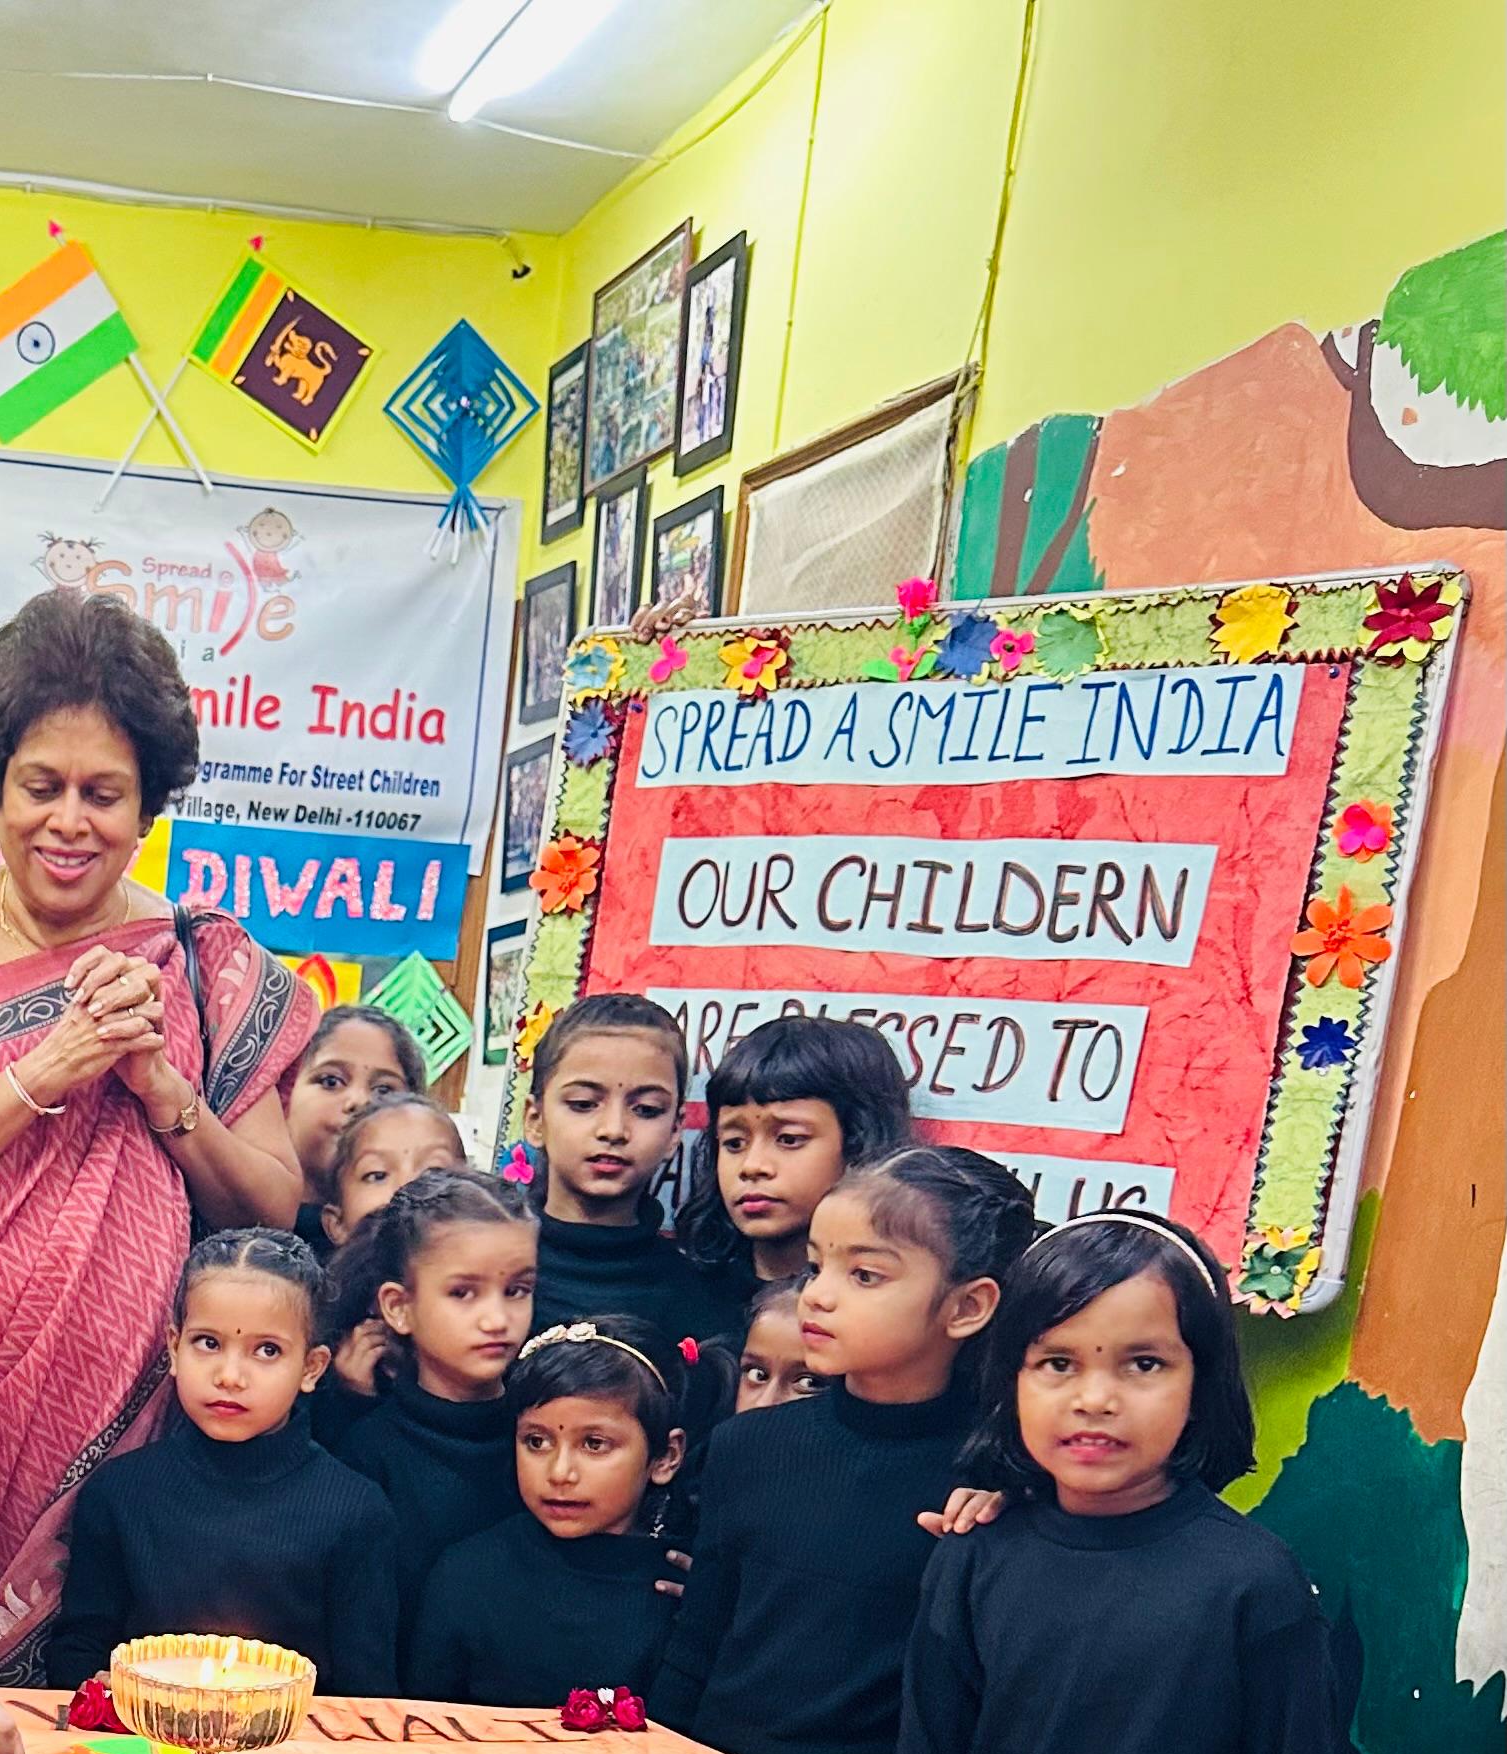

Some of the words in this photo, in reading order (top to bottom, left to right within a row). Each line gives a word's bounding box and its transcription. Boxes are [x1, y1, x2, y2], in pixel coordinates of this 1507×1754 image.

[142, 556, 213, 582] Spread
[190, 674, 281, 730] mile
[307, 684, 446, 744] India
[641, 692, 810, 779] SPREAD
[823, 691, 857, 762] A
[868, 682, 1062, 768] SMILE
[1066, 673, 1286, 765] INDIA
[198, 759, 273, 785] gramme
[278, 762, 307, 787] For
[311, 765, 364, 792] Street
[369, 769, 441, 797] Children
[247, 801, 289, 823] New
[294, 804, 342, 827] Delhi
[346, 808, 422, 832] -110067
[178, 847, 442, 922] DIWALI
[677, 853, 798, 932] OUR
[817, 855, 1191, 945] CHILDERN
[1047, 1017, 1125, 1103] TO
